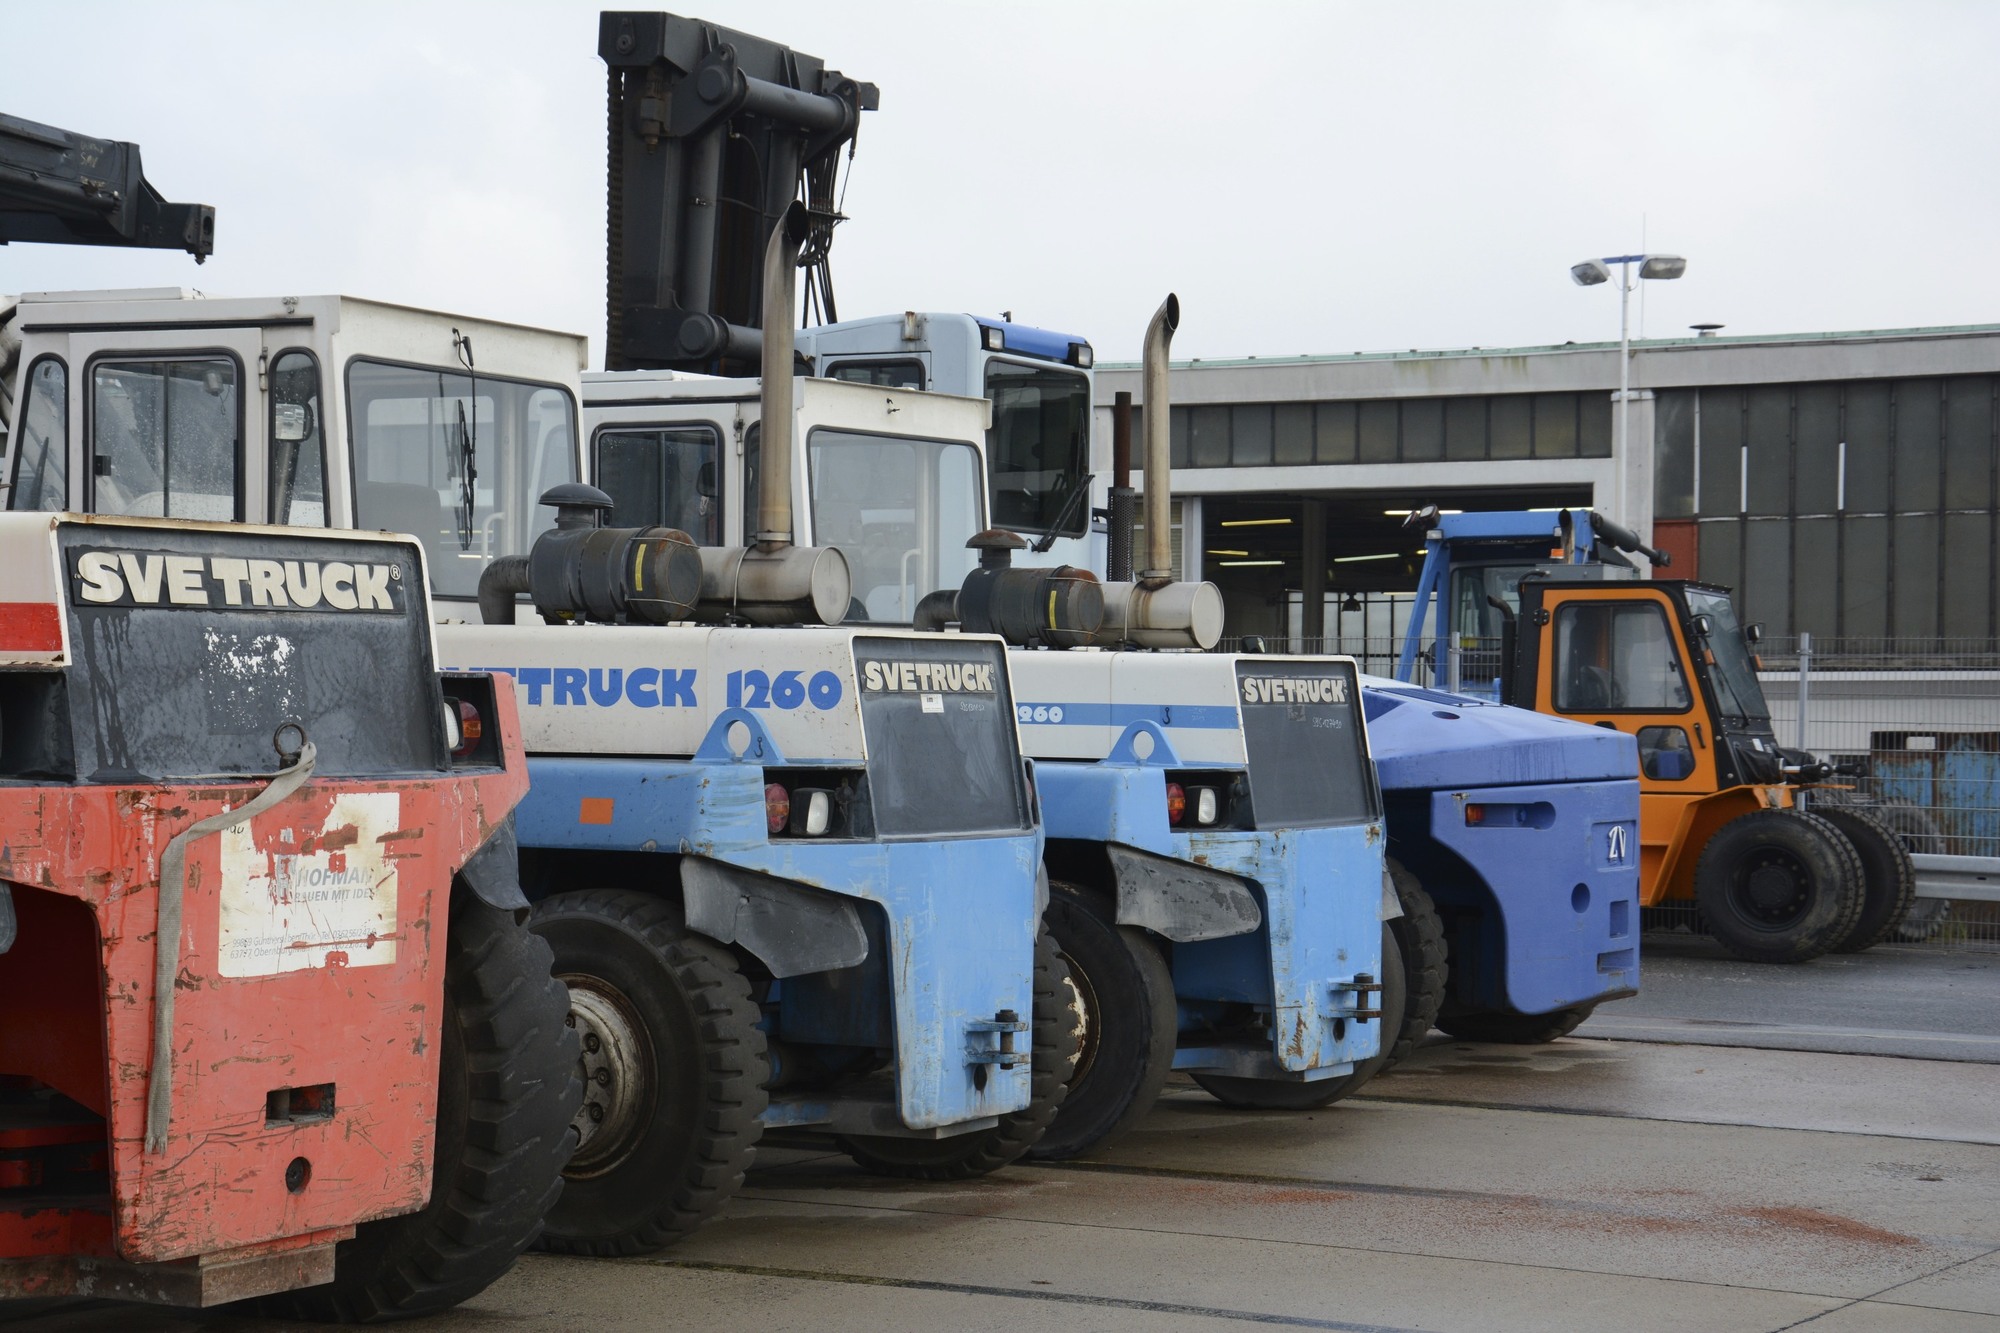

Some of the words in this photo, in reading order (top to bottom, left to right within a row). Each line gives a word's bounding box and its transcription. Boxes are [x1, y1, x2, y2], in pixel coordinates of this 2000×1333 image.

[77, 551, 394, 611] SVETRUCK
[438, 666, 698, 708] TRUCK
[726, 669, 843, 711] 1260
[865, 661, 993, 691] SVETRUCK
[1243, 678, 1346, 703] SVETRUCK
[1016, 705, 1064, 723] 260
[331, 888, 352, 901] MIT
